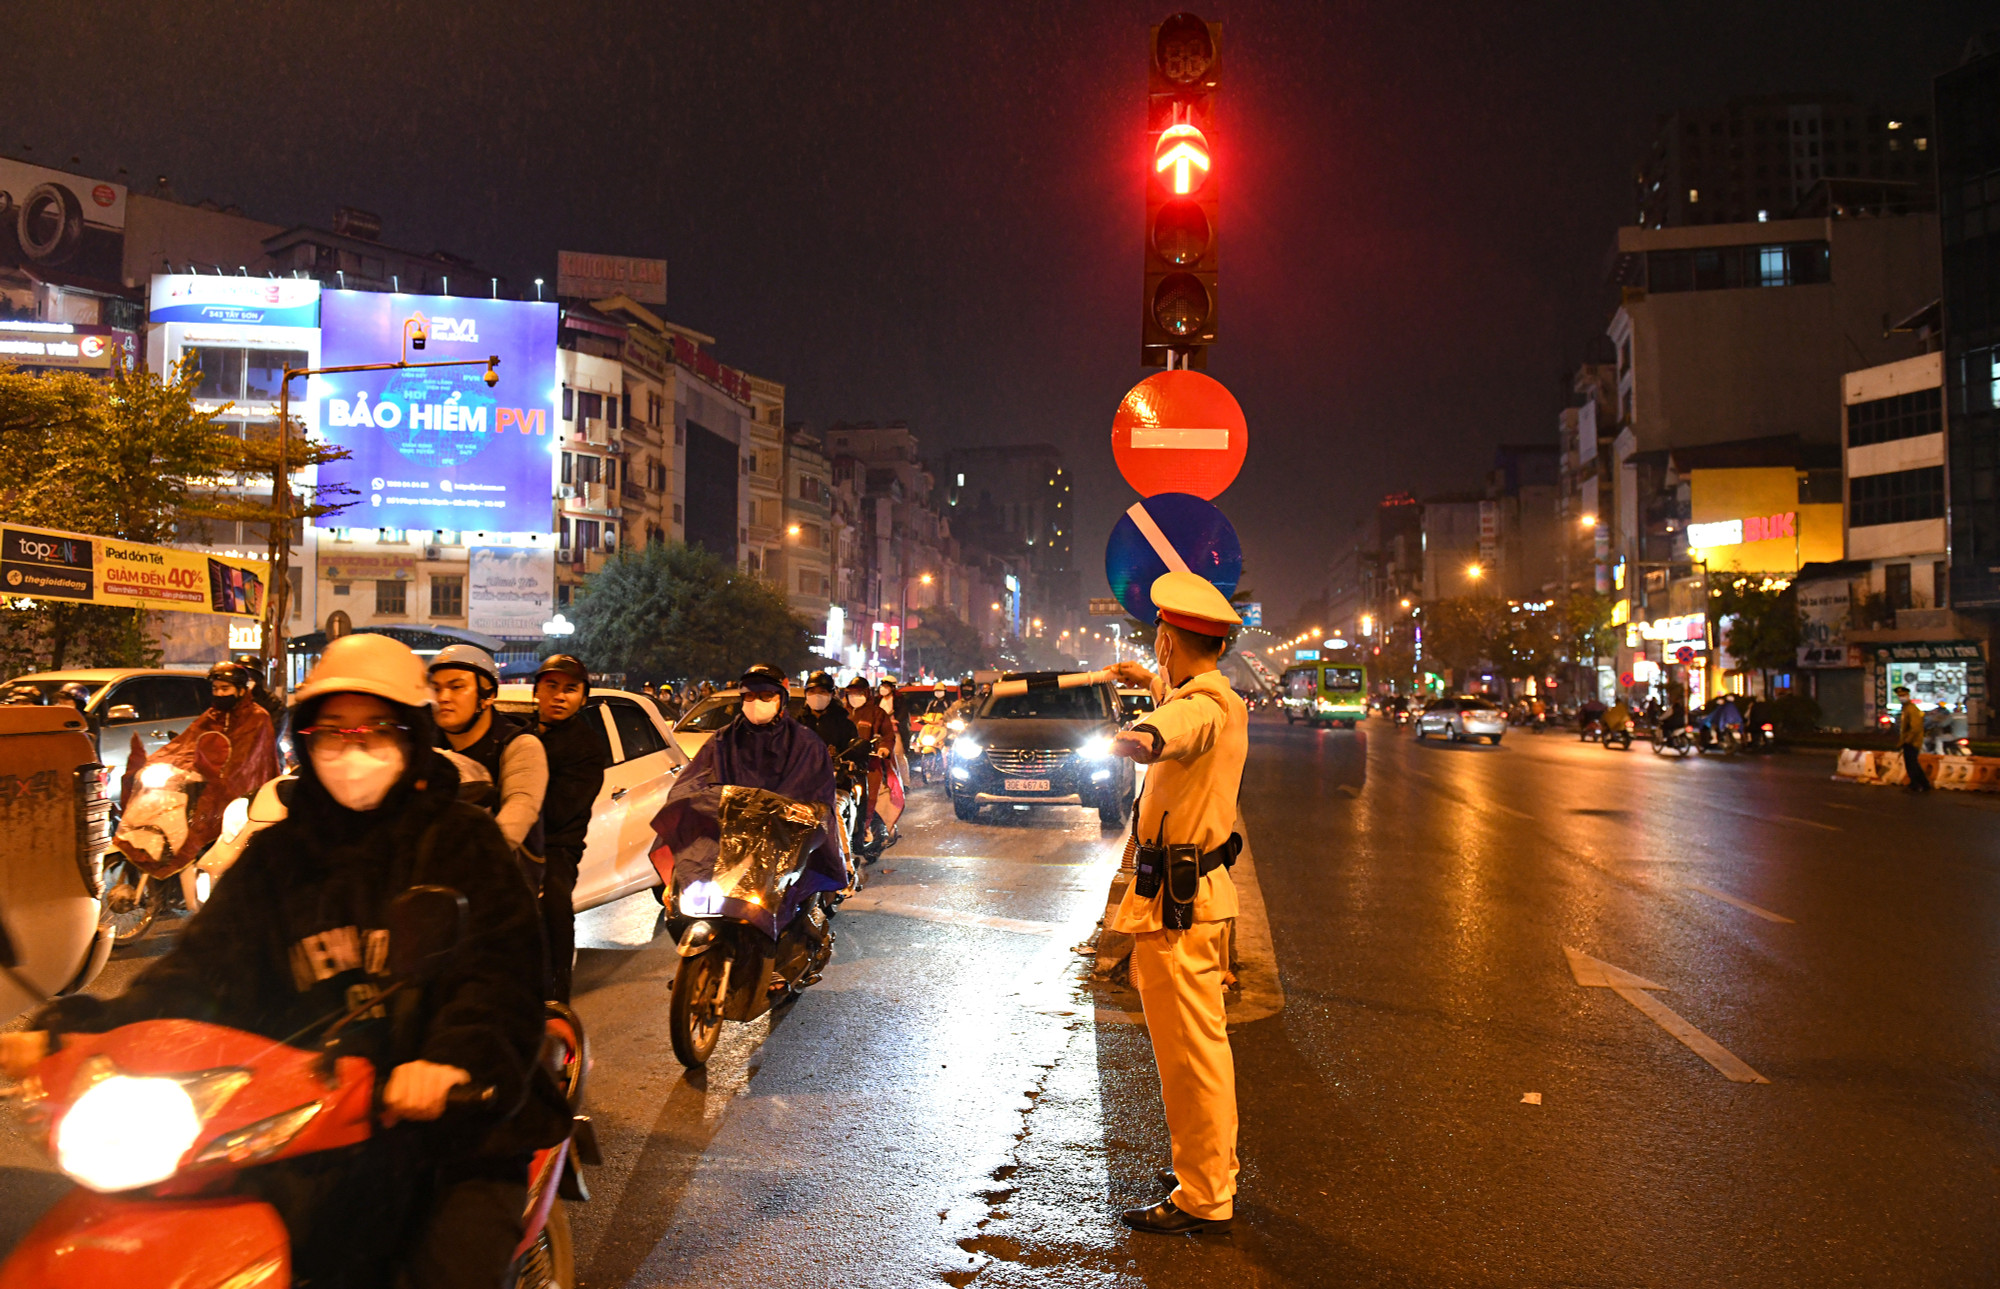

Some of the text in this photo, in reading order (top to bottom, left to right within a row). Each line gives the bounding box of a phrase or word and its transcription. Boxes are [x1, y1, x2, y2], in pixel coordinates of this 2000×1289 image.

[431, 316, 476, 334] PVI
[329, 390, 546, 436] BẢO HIỂM PVI
[1744, 511, 1796, 542] BUK
[105, 546, 164, 565] iPad đón Tết
[24, 575, 87, 591] thegioididong
[107, 565, 203, 589] GIẢM ĐẾN 40%
[138, 587, 143, 595] 2
